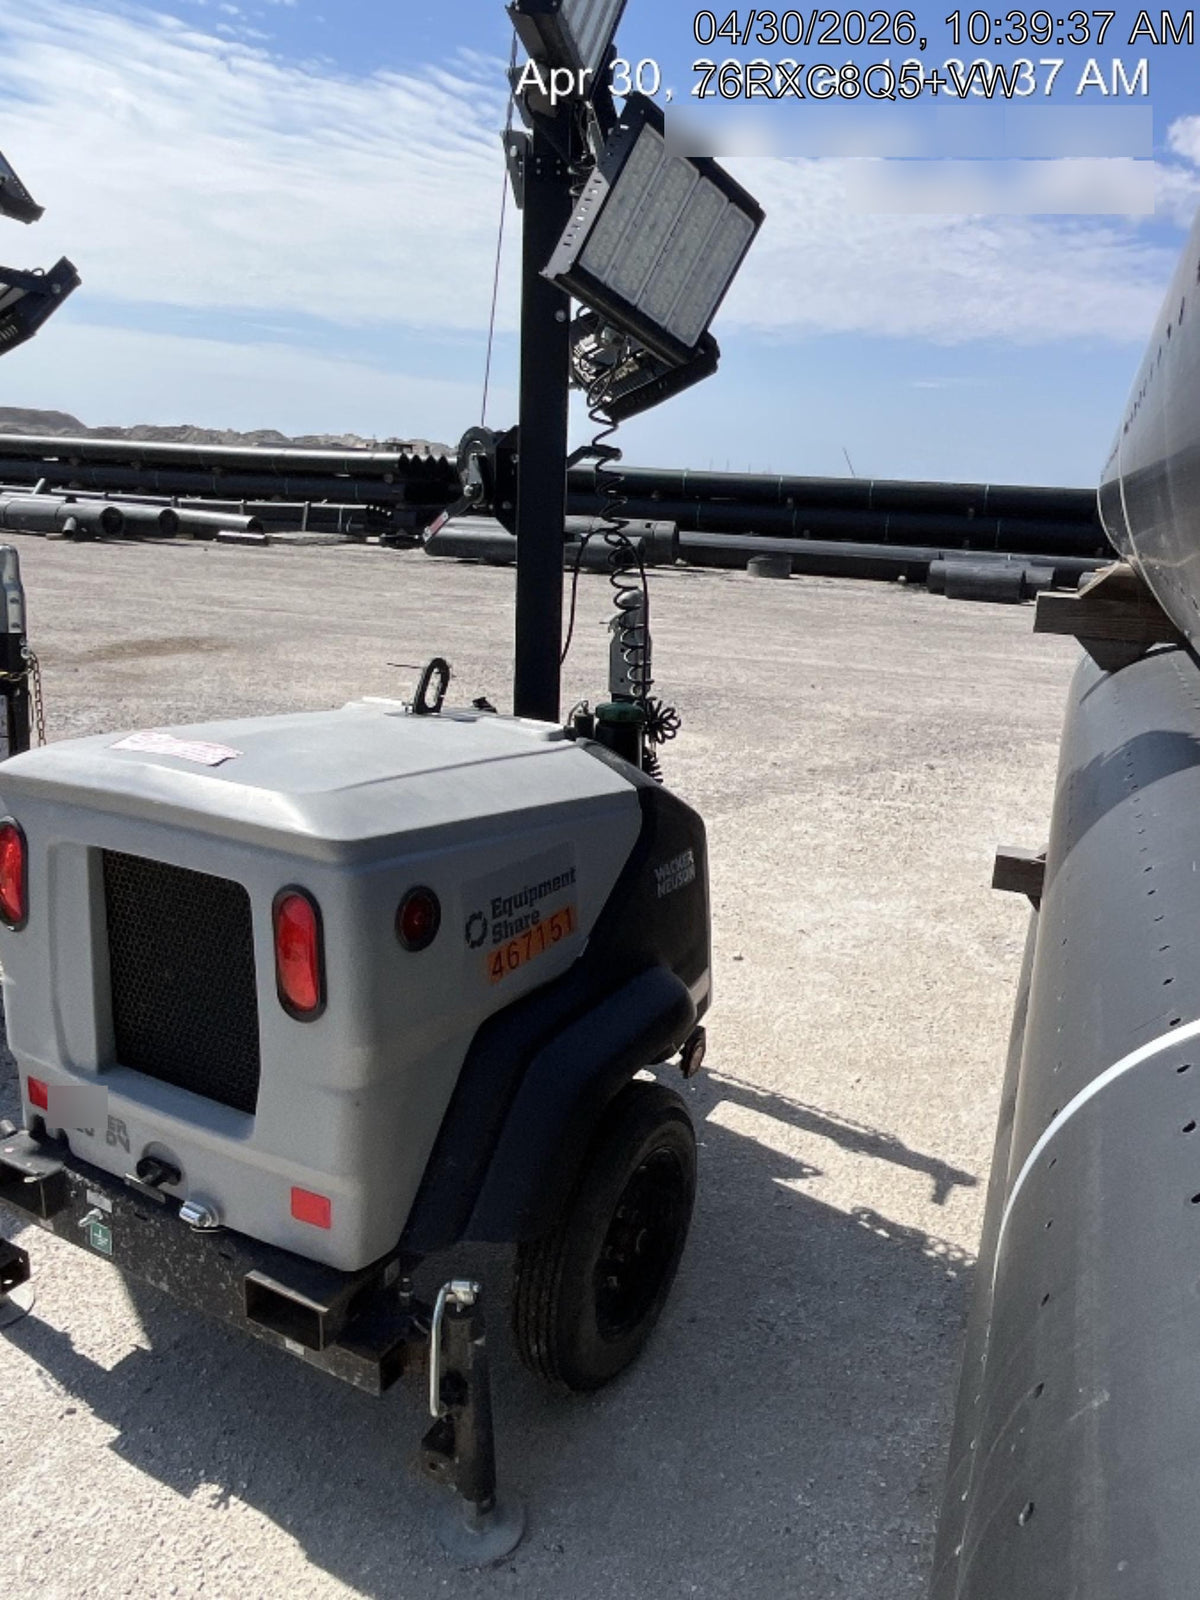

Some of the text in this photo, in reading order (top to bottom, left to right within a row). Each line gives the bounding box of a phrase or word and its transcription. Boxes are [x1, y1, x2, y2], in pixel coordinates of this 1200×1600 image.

[491, 867, 576, 919] Equipment
[491, 906, 573, 977] 467151
[492, 910, 540, 944] Share
